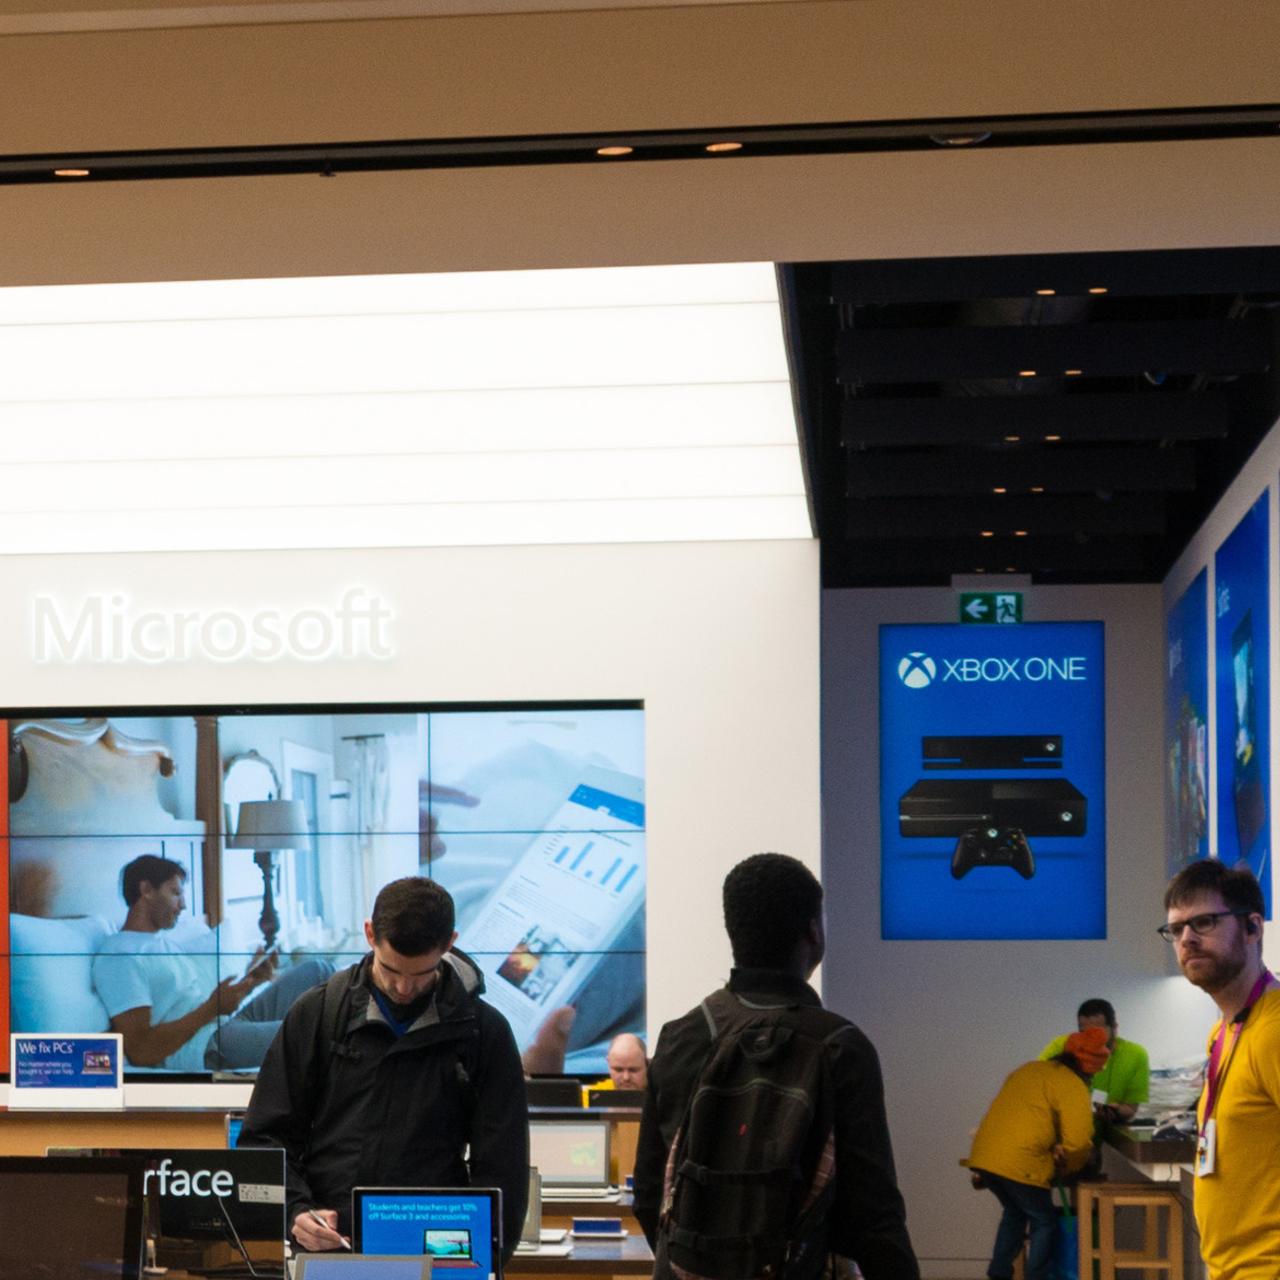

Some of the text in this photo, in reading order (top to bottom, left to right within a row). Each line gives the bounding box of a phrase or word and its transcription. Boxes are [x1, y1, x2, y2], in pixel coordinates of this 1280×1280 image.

[32, 587, 393, 661] Microsoft
[942, 657, 1088, 682] XBOX ONE
[19, 1042, 37, 1054] We
[39, 1041, 51, 1054] fix
[143, 1158, 234, 1197] rface
[368, 1202, 400, 1211] Students
[401, 1202, 416, 1211] and
[417, 1202, 447, 1211] teachers
[449, 1204, 460, 1213] get
[368, 1212, 379, 1220] off
